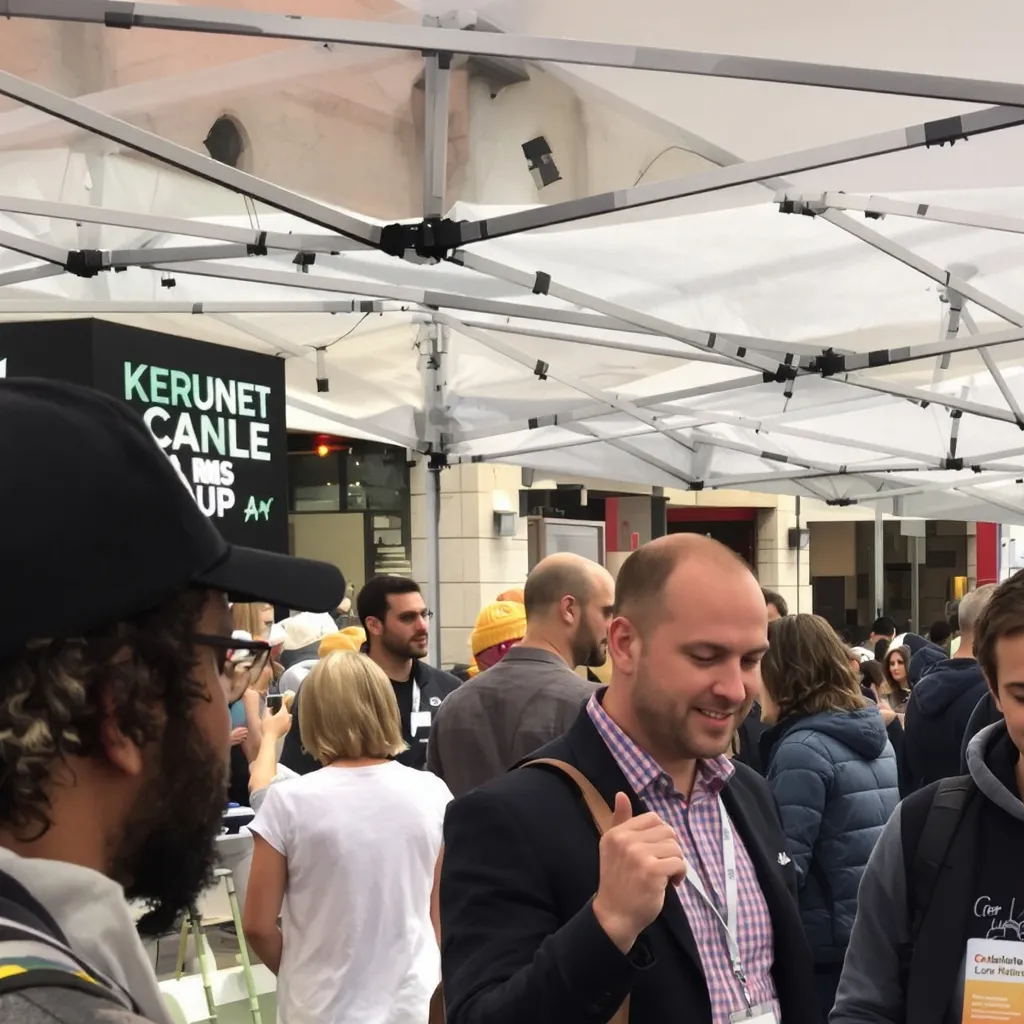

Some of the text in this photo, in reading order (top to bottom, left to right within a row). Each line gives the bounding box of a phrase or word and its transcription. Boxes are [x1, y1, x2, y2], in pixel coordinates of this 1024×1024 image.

[124, 361, 271, 419] KERUNET
[143, 406, 271, 461] CANLE
[195, 484, 236, 518] UP
